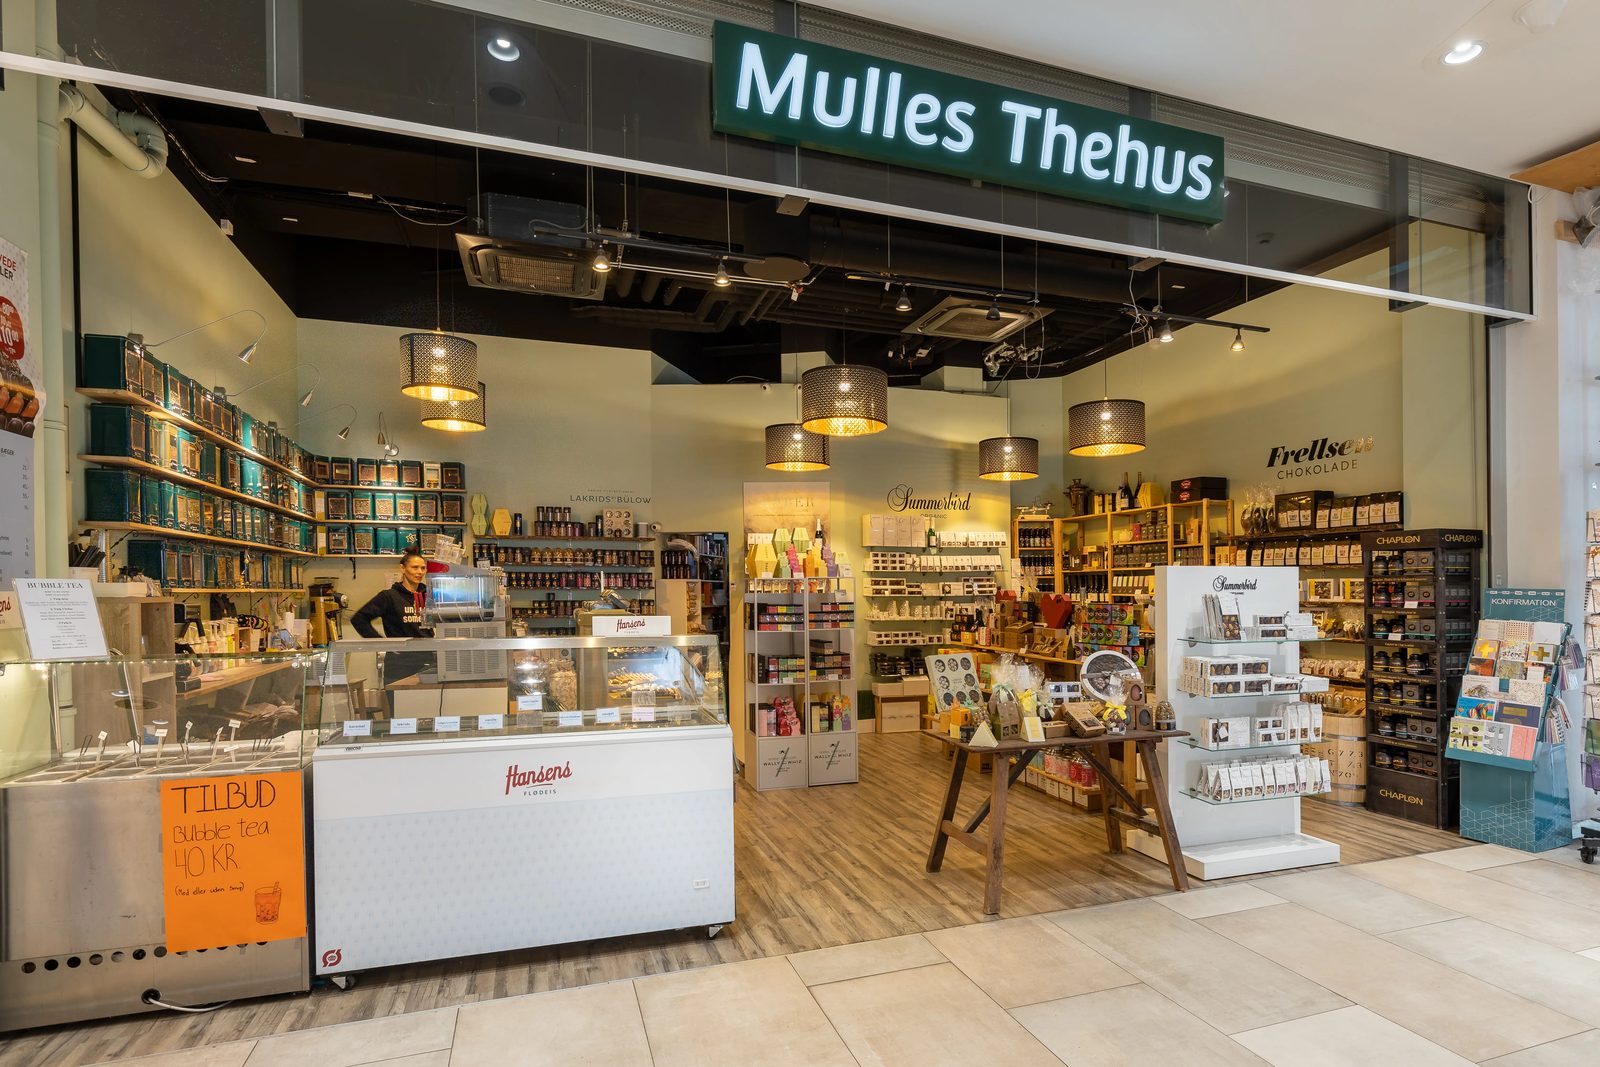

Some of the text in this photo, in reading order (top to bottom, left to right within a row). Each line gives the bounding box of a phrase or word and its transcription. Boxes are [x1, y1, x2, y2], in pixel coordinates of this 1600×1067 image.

[736, 41, 1214, 200] Mulles Thehus
[1277, 459, 1358, 479] CHOKOLADE
[570, 495, 611, 503] LAKRIDS
[887, 484, 971, 512] Summerbird
[1376, 535, 1421, 545] CHAPLON
[1444, 534, 1477, 542] CHAPLON
[1213, 575, 1257, 592] Summerbird
[1491, 598, 1556, 607] KONFIRMATION
[616, 619, 646, 632] Hansens
[505, 761, 572, 795] Hansens
[171, 780, 275, 814] TILBUD
[1380, 789, 1424, 806] CHAPLON
[237, 818, 270, 837] tea
[175, 846, 205, 879] 40
